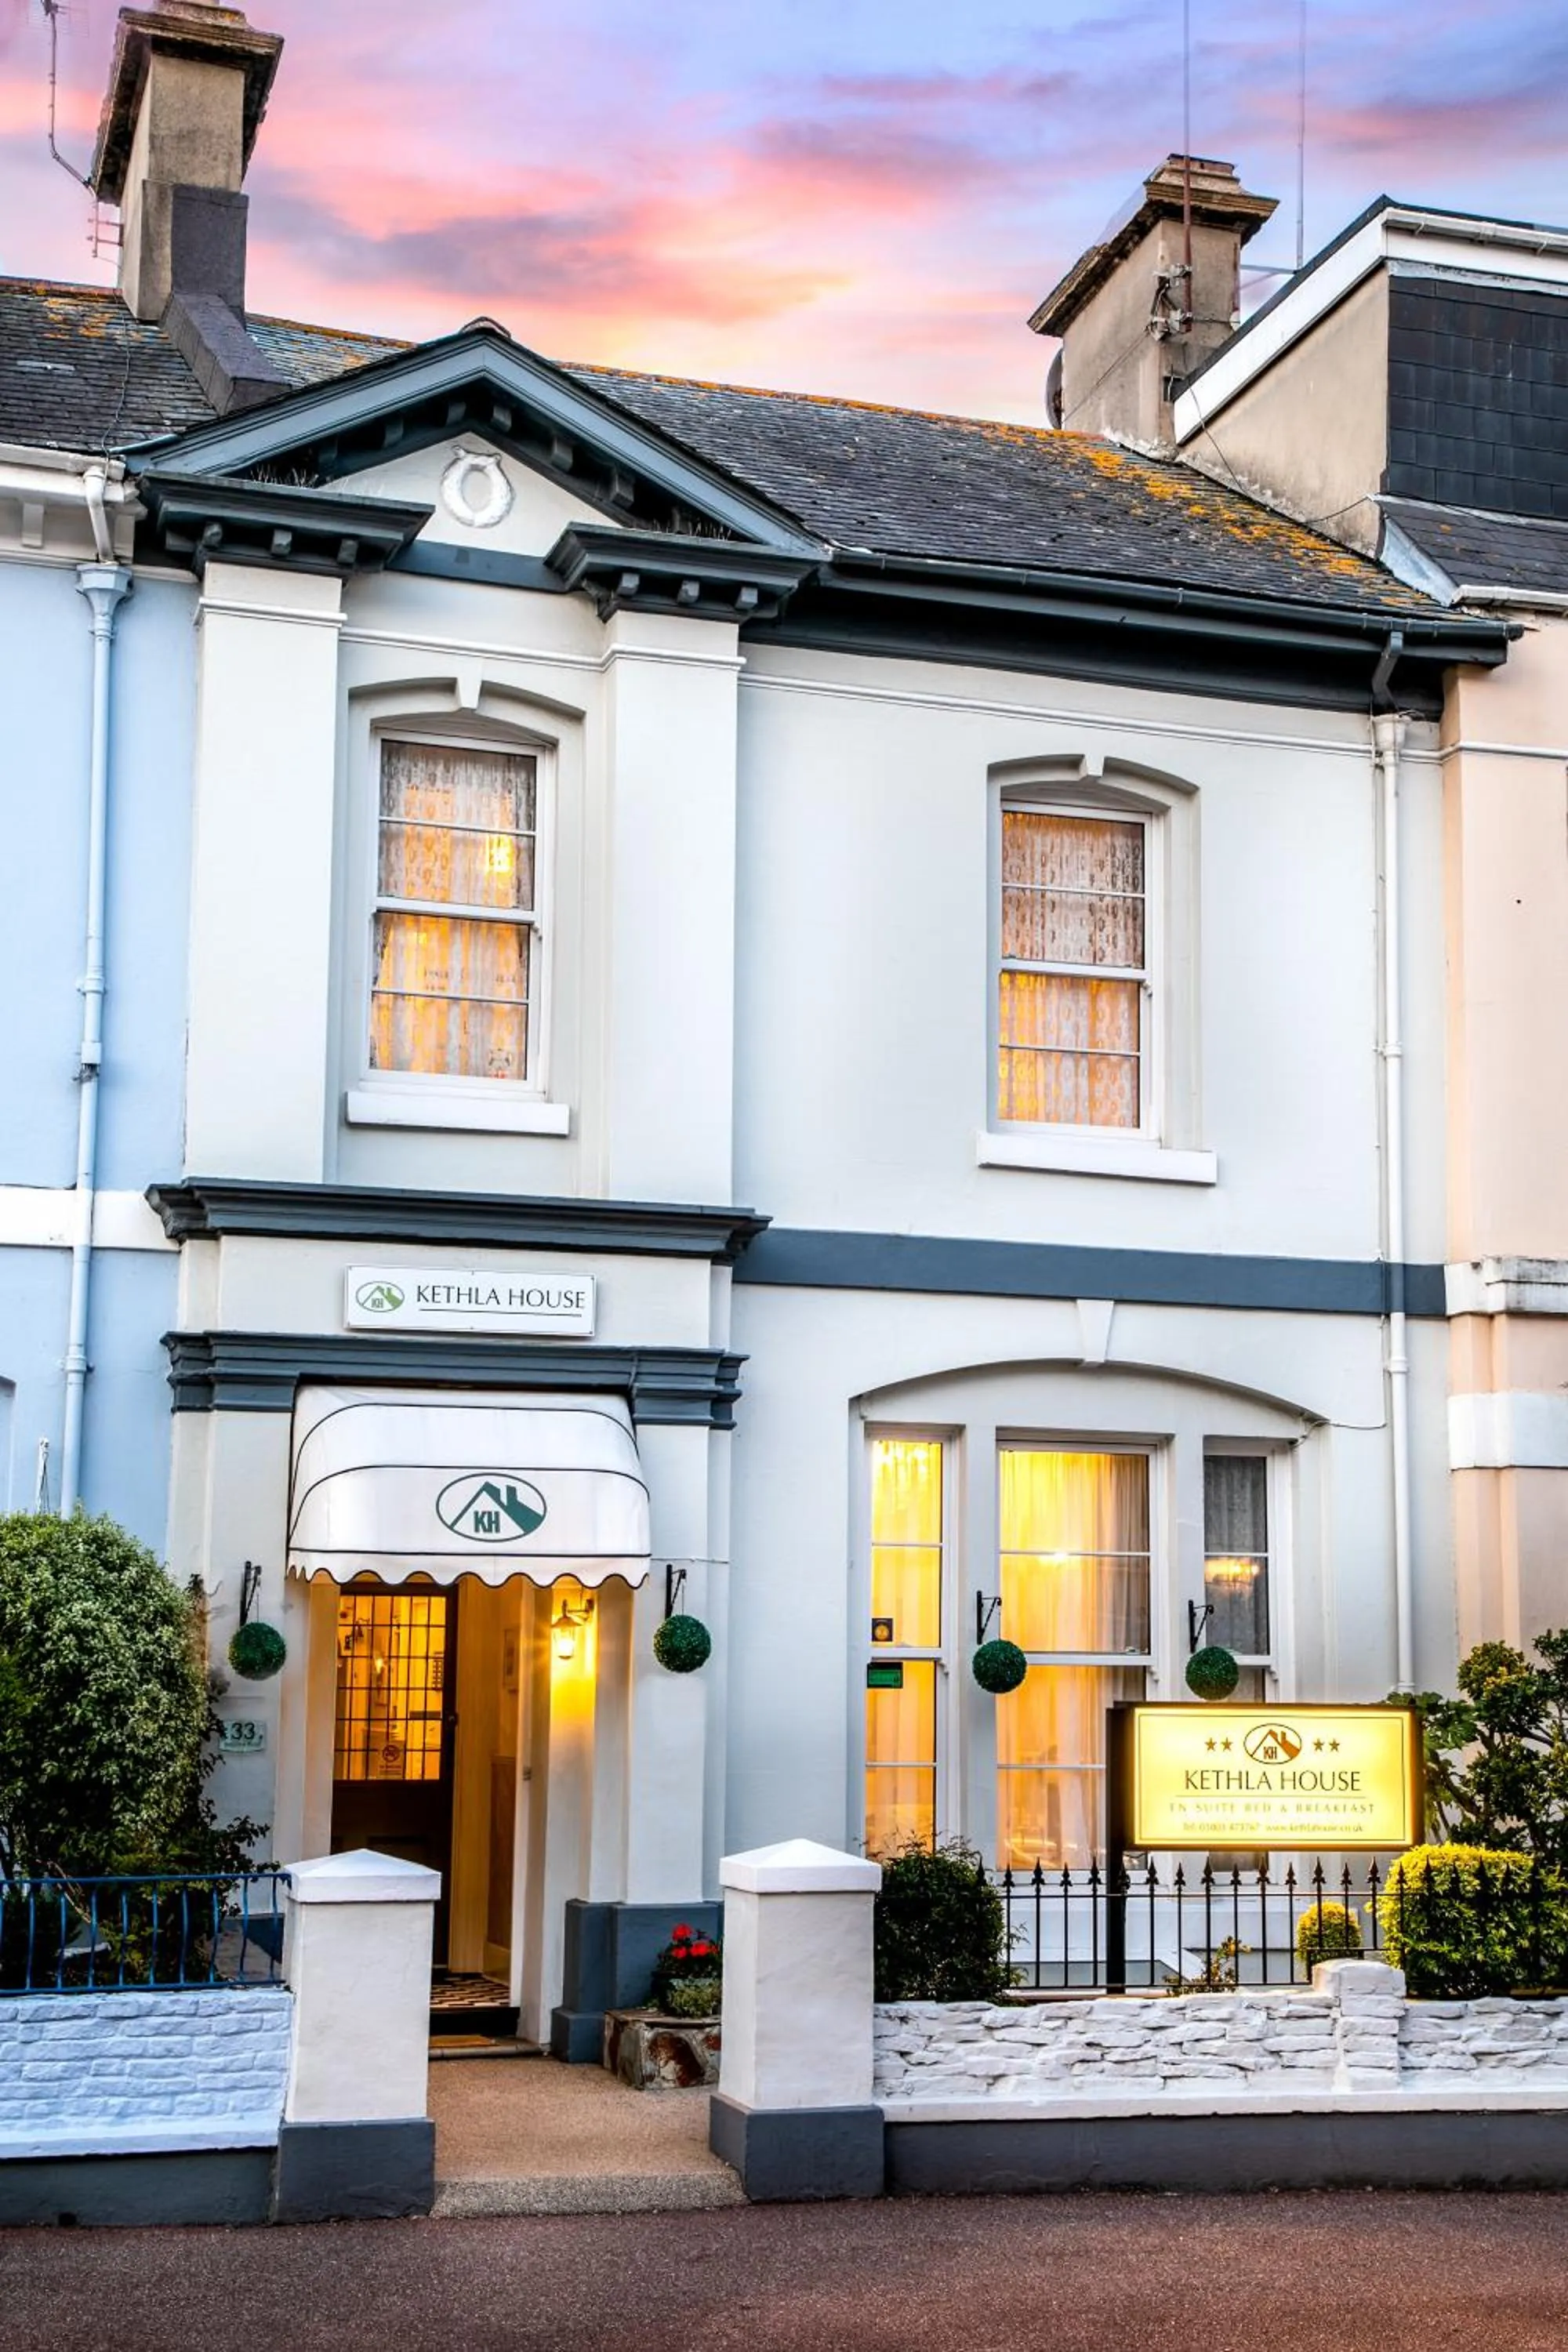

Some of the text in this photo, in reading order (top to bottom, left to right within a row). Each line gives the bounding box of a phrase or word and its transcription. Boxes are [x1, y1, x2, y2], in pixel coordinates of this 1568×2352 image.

[416, 1285, 585, 1308] KETHLA HOUSE
[474, 1511, 500, 1534] KH
[231, 1722, 255, 1740] 33
[1263, 1746, 1277, 1759] KH
[1185, 1769, 1360, 1791] KETHLA HOUSE
[1296, 1802, 1374, 1814] BREAKFAST
